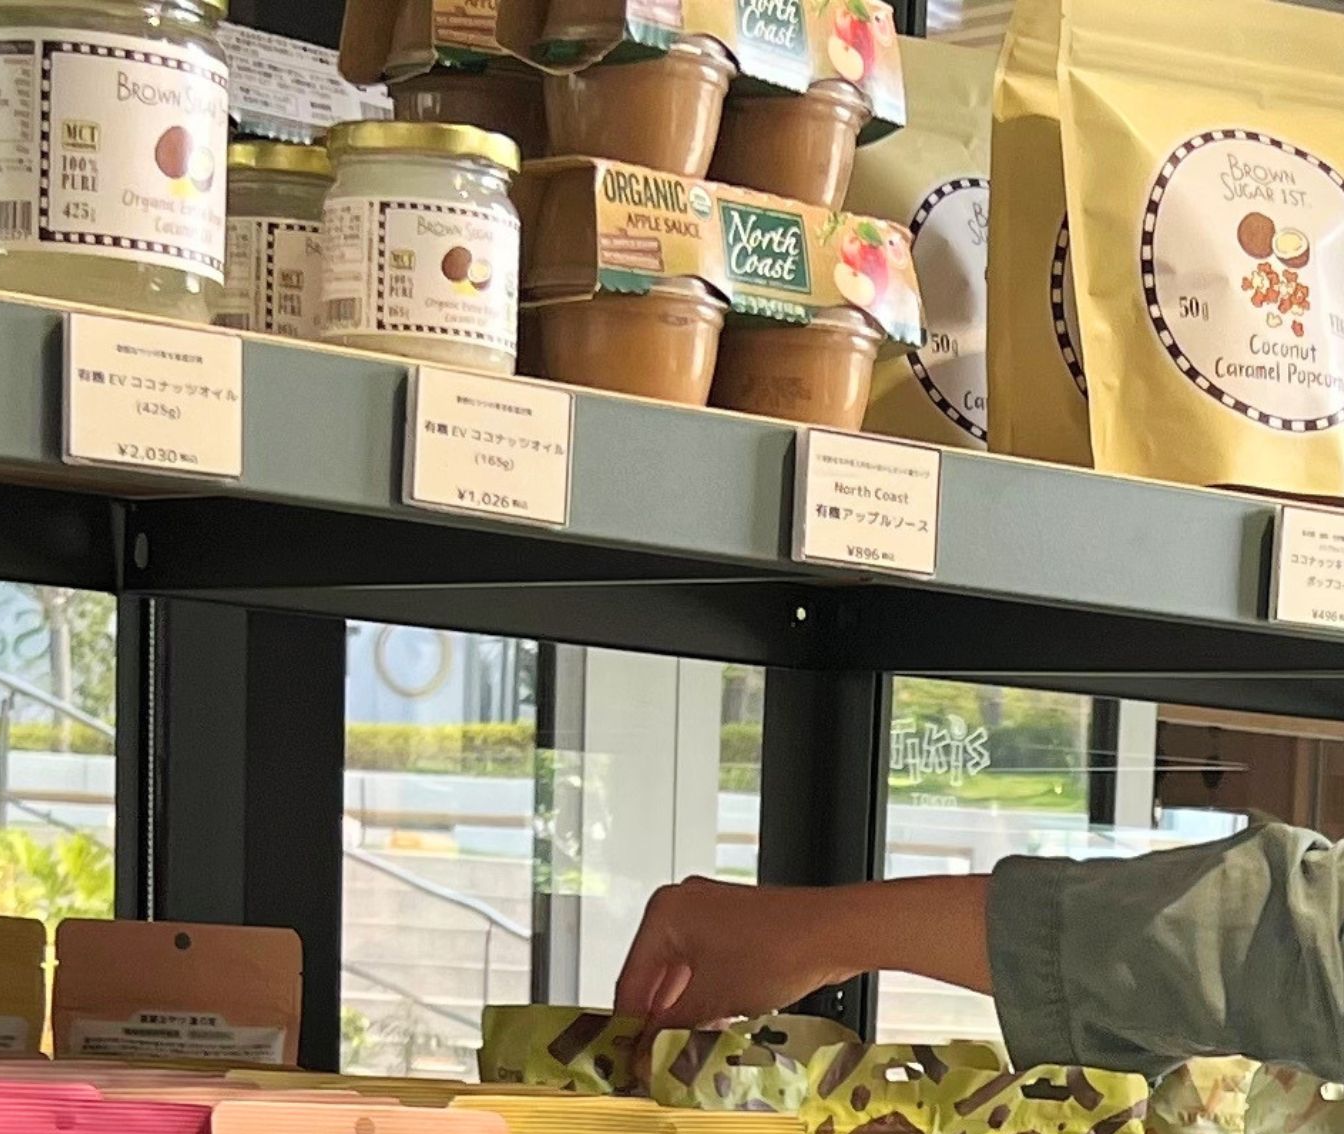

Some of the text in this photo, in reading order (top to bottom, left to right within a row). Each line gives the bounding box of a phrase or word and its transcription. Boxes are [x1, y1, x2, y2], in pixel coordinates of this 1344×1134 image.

[741, 9, 796, 48] Coast
[1227, 153, 1296, 186] BROWN
[603, 170, 687, 214] ORGANIC
[1220, 172, 1274, 202] SUGAR
[627, 212, 701, 239] APPLE SAUCE
[728, 211, 799, 253] North
[731, 245, 796, 281] Coast
[1179, 297, 1209, 320] 50g
[931, 332, 958, 357] 50g
[1249, 334, 1317, 363] Coconut
[1215, 357, 1344, 392] Caramel Popcorn
[136, 401, 182, 420] (425g)
[834, 481, 909, 504] North Coast
